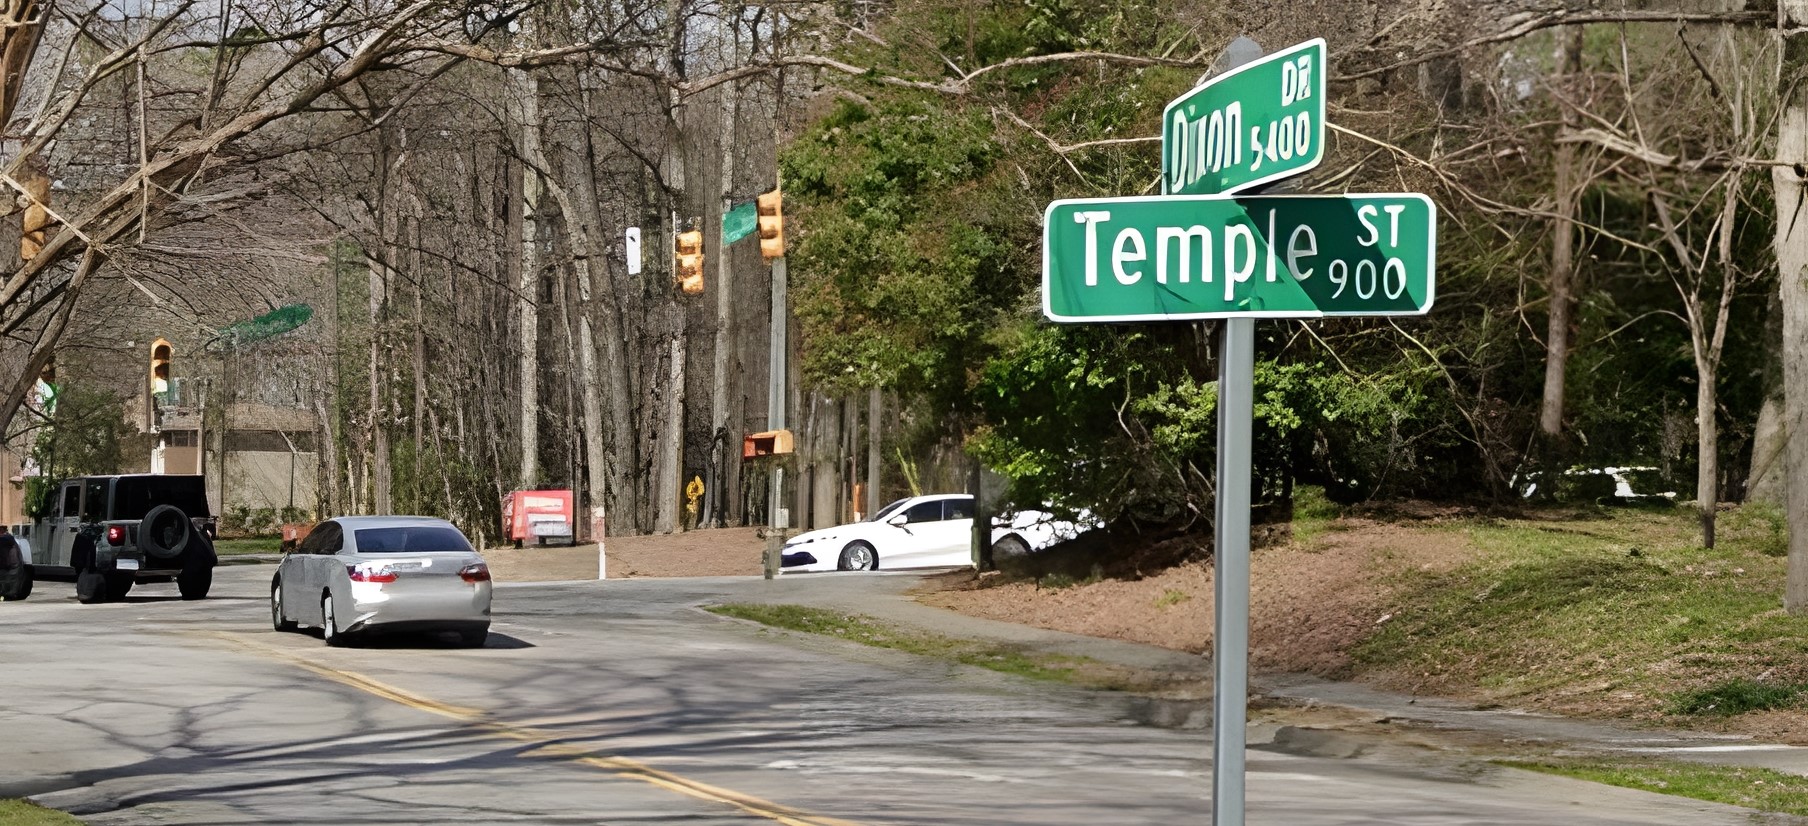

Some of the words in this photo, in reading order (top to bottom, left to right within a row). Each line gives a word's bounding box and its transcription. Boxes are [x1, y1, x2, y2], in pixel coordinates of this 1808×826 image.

[1073, 208, 1318, 301] Temple
[1356, 204, 1406, 248] ST
[1328, 257, 1407, 300] 900
